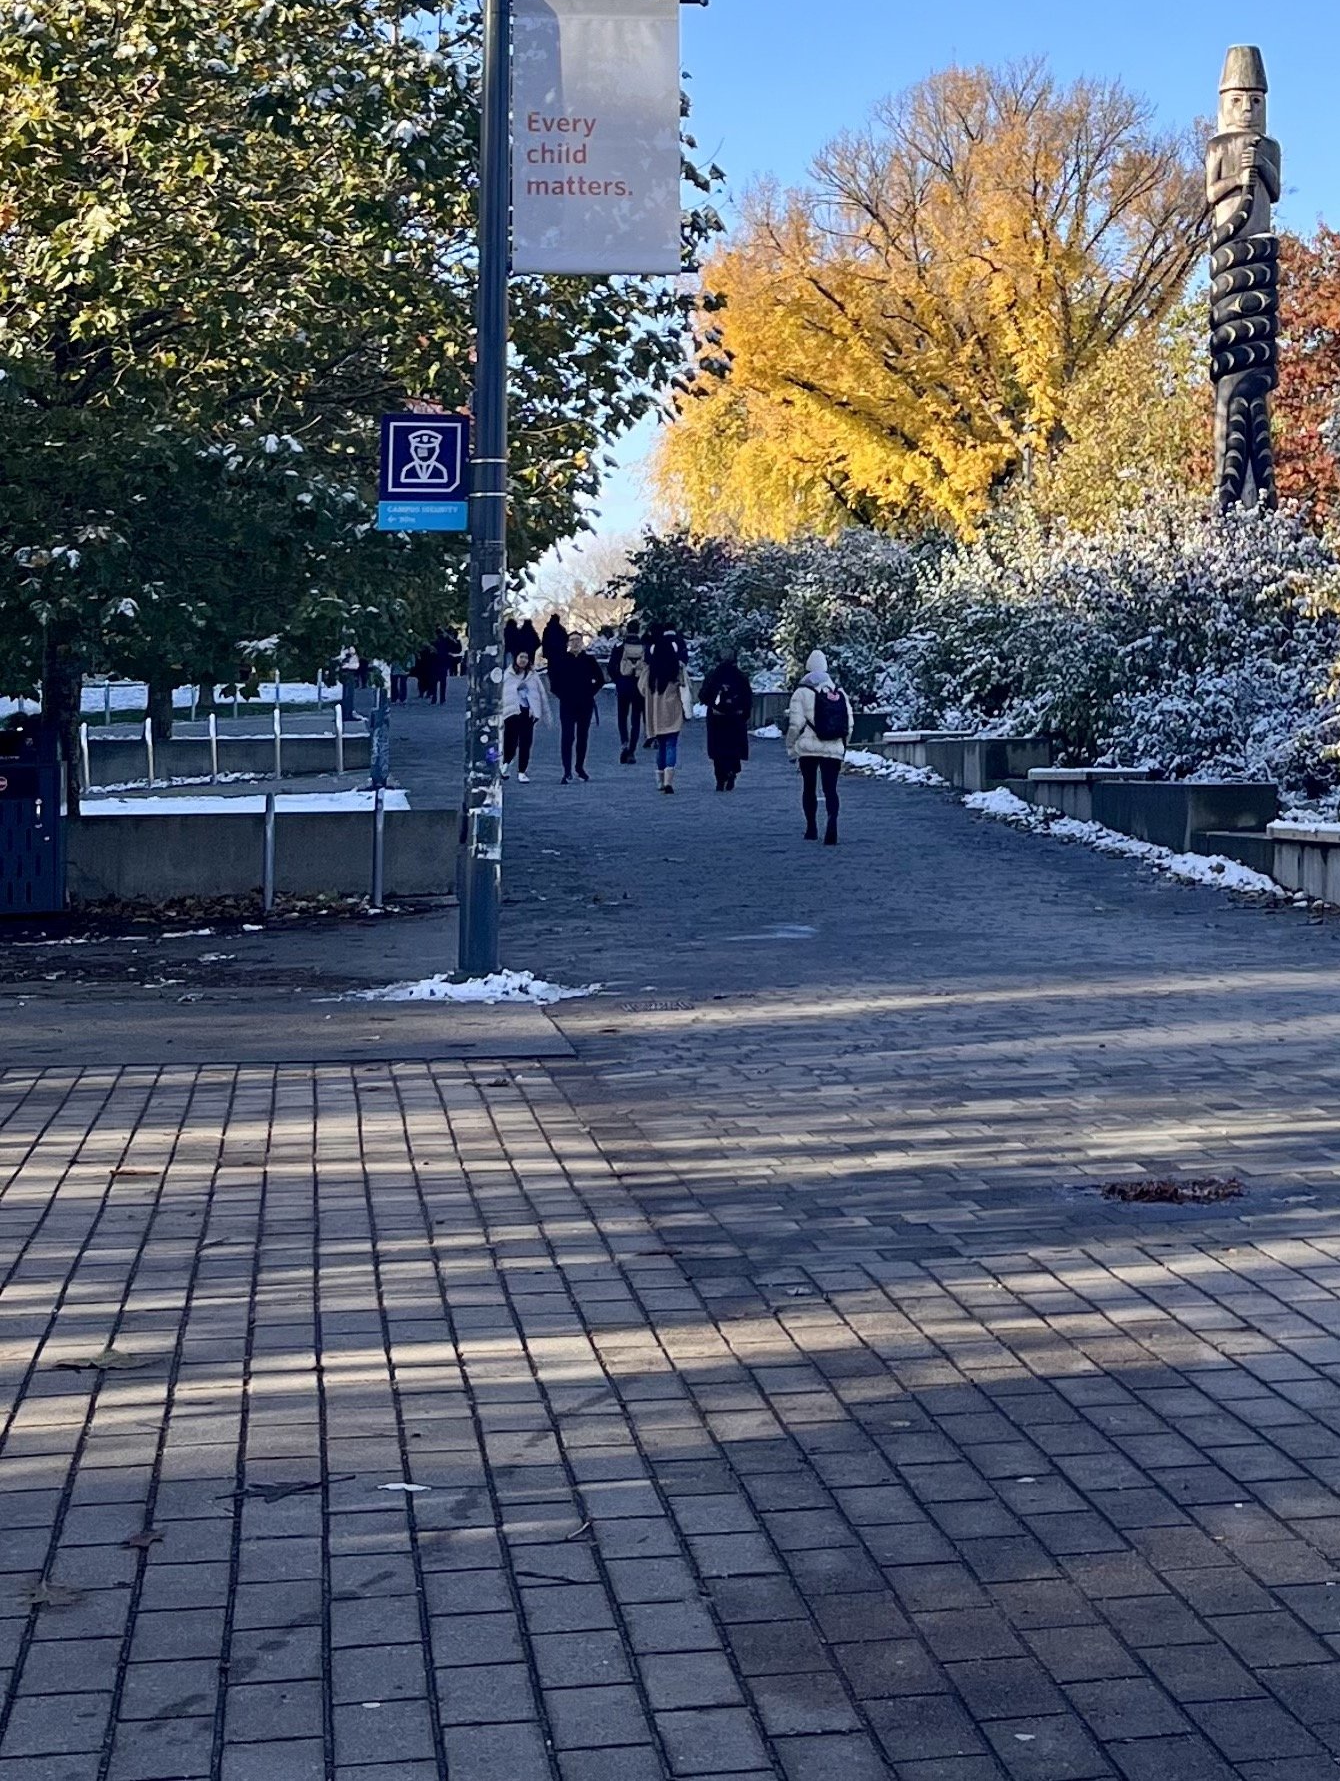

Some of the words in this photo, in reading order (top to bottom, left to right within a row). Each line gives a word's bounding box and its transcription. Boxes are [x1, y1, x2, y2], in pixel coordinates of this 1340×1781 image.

[527, 111, 597, 138] Every
[526, 142, 587, 165] child
[526, 176, 634, 197] matters.
